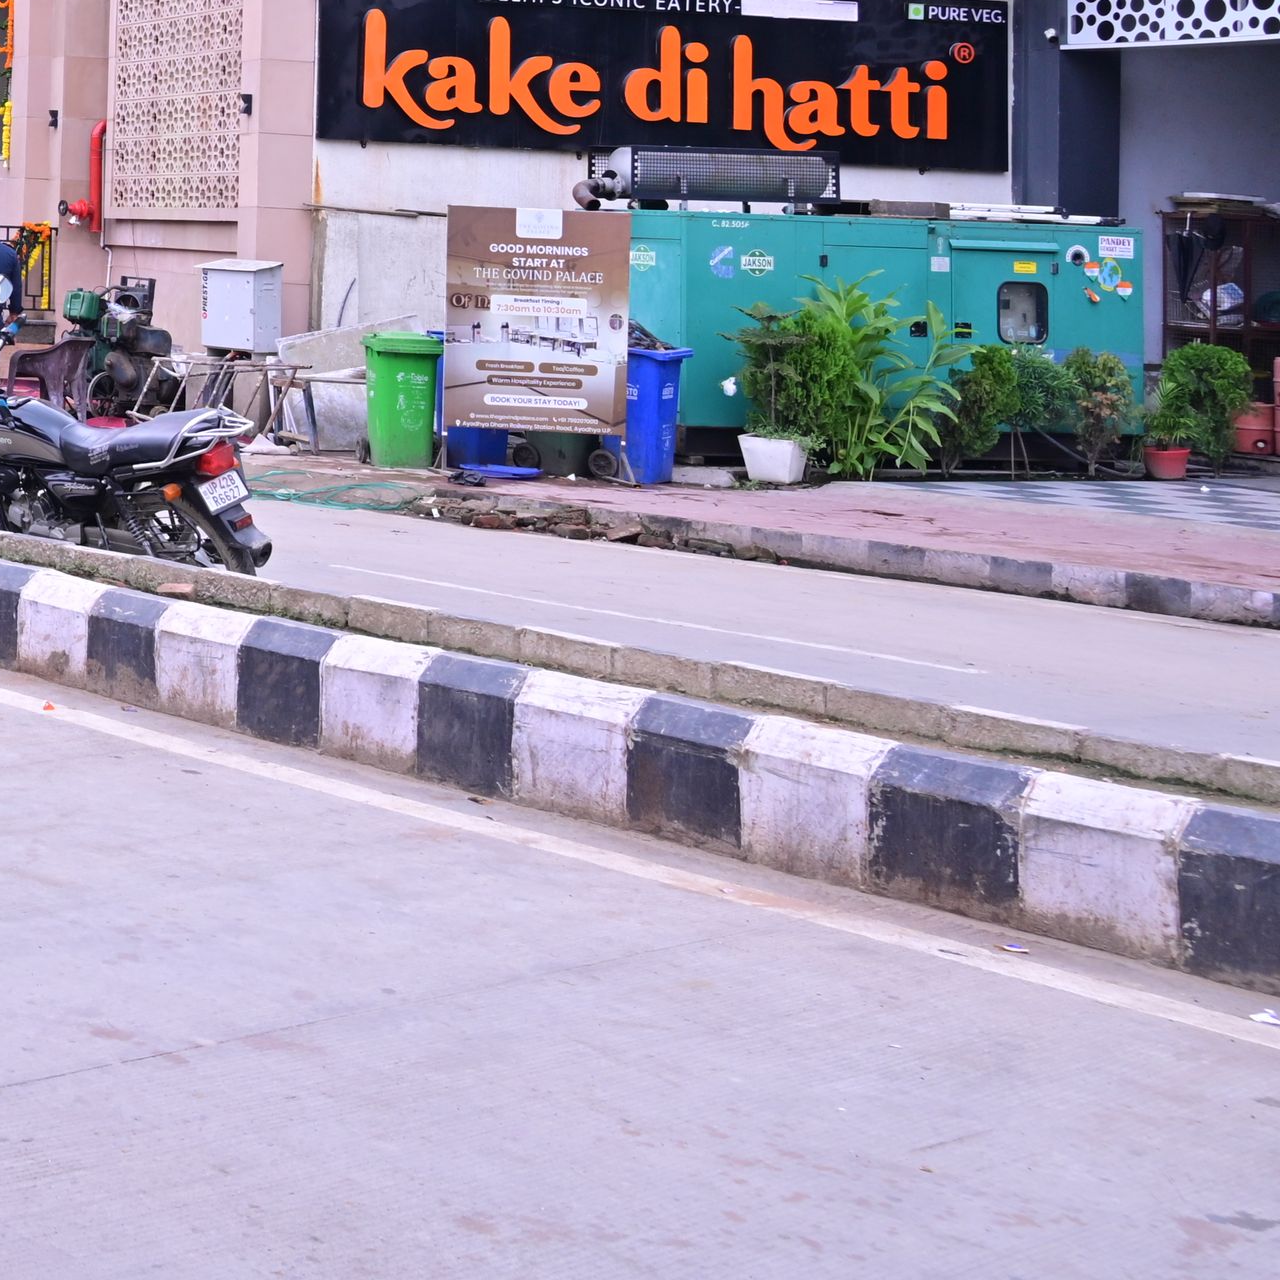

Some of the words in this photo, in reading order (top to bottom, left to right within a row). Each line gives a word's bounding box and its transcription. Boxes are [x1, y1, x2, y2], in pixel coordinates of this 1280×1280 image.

[928, 6, 967, 22] PURE
[971, 8, 1006, 24] VEG.
[363, 8, 601, 136] kake
[624, 25, 708, 124] di
[733, 34, 948, 152] hatti
[1100, 237, 1131, 246] PANDEY
[489, 243, 524, 253] GOOD
[526, 245, 589, 256] MORNINGS
[512, 257, 548, 267] START
[550, 259, 565, 268] AT
[630, 253, 655, 264] JAKSON
[743, 258, 772, 268] JAKSON
[473, 267, 500, 279] THE
[503, 269, 552, 281] GOVIND
[555, 271, 604, 283] PALACE
[497, 304, 530, 312] 7:30am
[532, 305, 541, 313] to
[543, 306, 582, 315] 10:30am
[511, 378, 542, 386] Hospitality
[552, 399, 580, 407] TODAY!
[462, 420, 489, 428] Ayodhya
[212, 485, 241, 507] R6627
